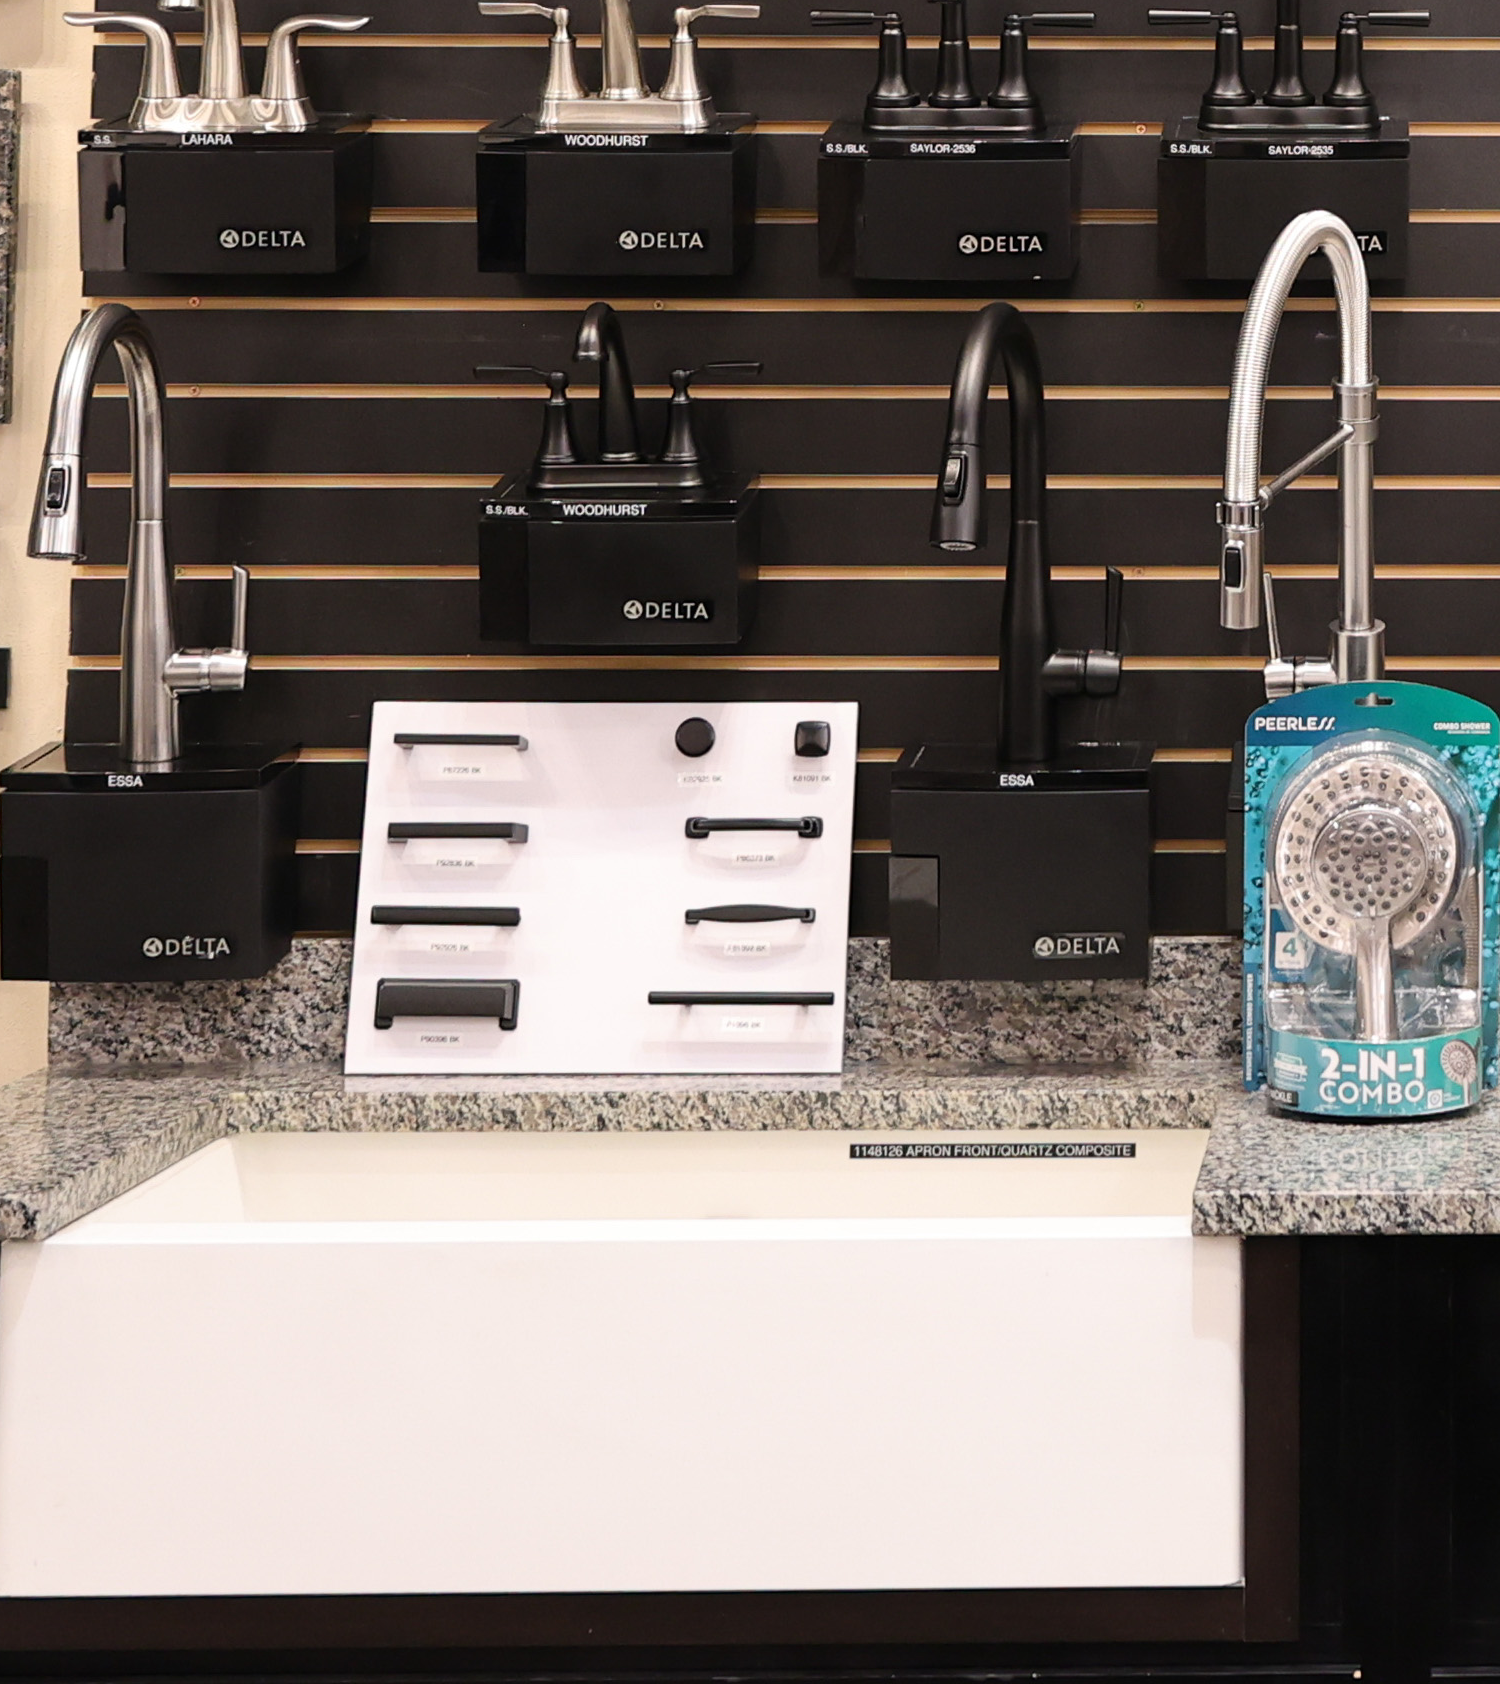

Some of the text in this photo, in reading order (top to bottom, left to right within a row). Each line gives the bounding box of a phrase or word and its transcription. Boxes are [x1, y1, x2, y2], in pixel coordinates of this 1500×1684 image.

[181, 134, 233, 145] LAHARA
[564, 134, 649, 147] WOODHURST
[242, 230, 306, 247] DELTA
[641, 232, 704, 249] DELTA
[980, 235, 1043, 252] DELTA
[562, 503, 648, 516] WOODHURST
[645, 602, 709, 619] DELTA
[1254, 716, 1336, 731] PEERLESS
[1433, 722, 1491, 731] COMBO SHOWER
[108, 774, 144, 787] ESSA
[999, 774, 1035, 787] ESSA
[165, 937, 231, 956] DELTA
[1056, 936, 1120, 955] DELTA
[1281, 936, 1299, 958] 4
[1319, 1047, 1426, 1082] 2-IN-1
[1318, 1080, 1425, 1106] COMBO
[854, 1144, 1131, 1157] 1148126 APRON FRONT/QUARTZ COMPOSITE
